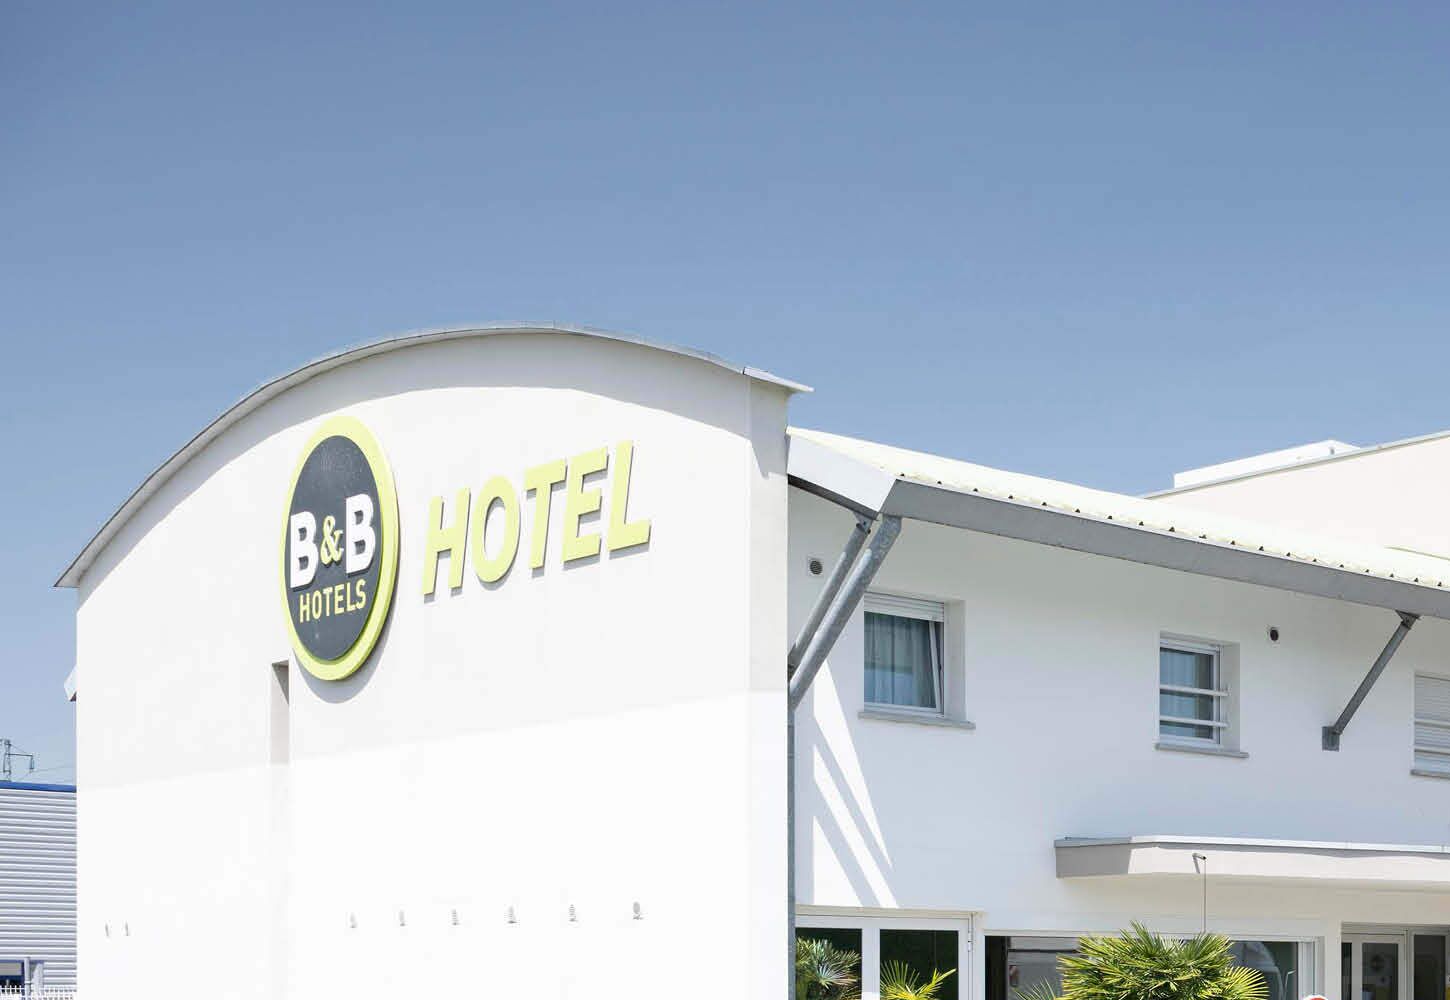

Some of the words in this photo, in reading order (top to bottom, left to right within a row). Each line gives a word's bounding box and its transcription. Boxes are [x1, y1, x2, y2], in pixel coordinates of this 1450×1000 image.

[289, 493, 376, 588] B&B
[423, 440, 651, 595] HOTEL
[299, 579, 366, 623] HOTELS
